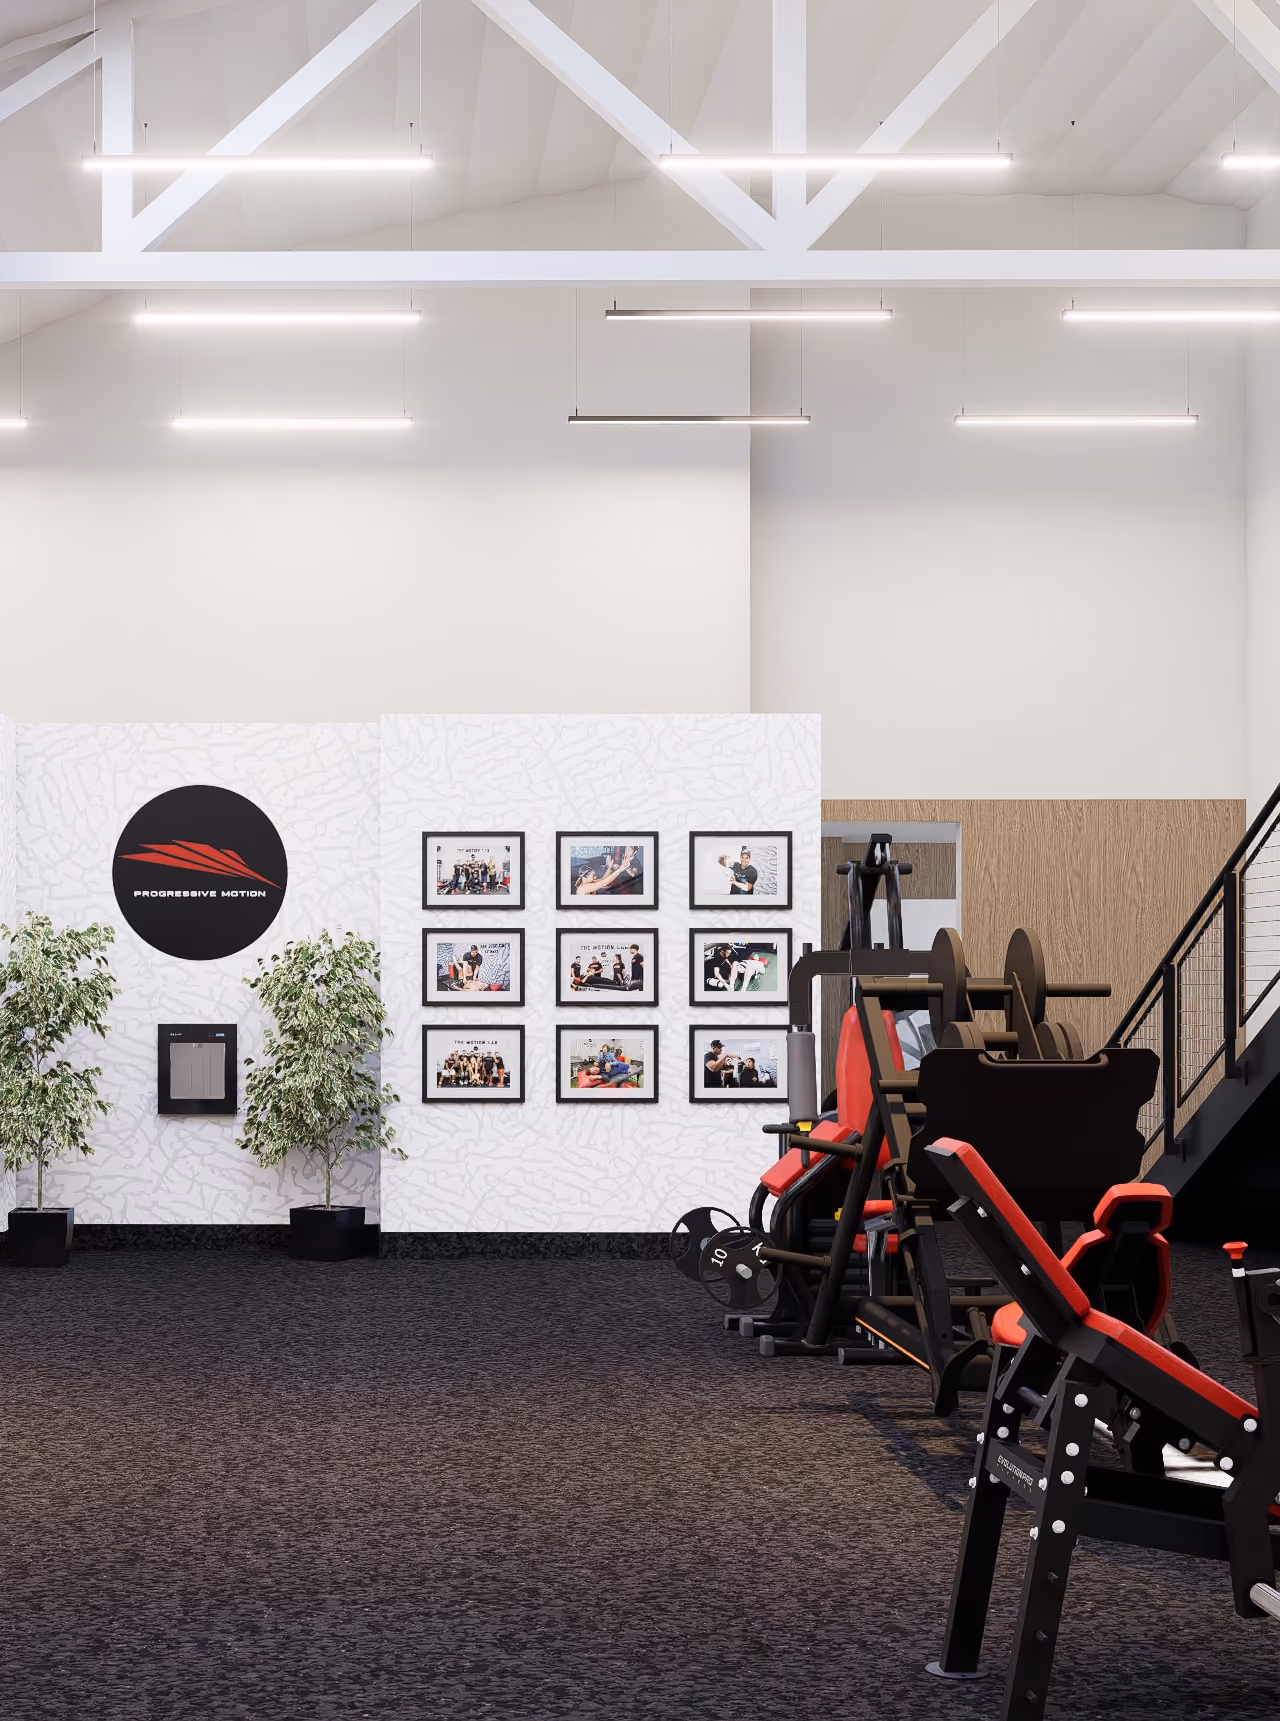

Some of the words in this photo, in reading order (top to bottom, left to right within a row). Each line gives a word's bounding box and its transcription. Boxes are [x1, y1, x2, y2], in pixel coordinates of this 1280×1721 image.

[133, 890, 217, 898] PROGRESSIVE
[221, 890, 267, 898] MOTION
[711, 1248, 728, 1268] 10
